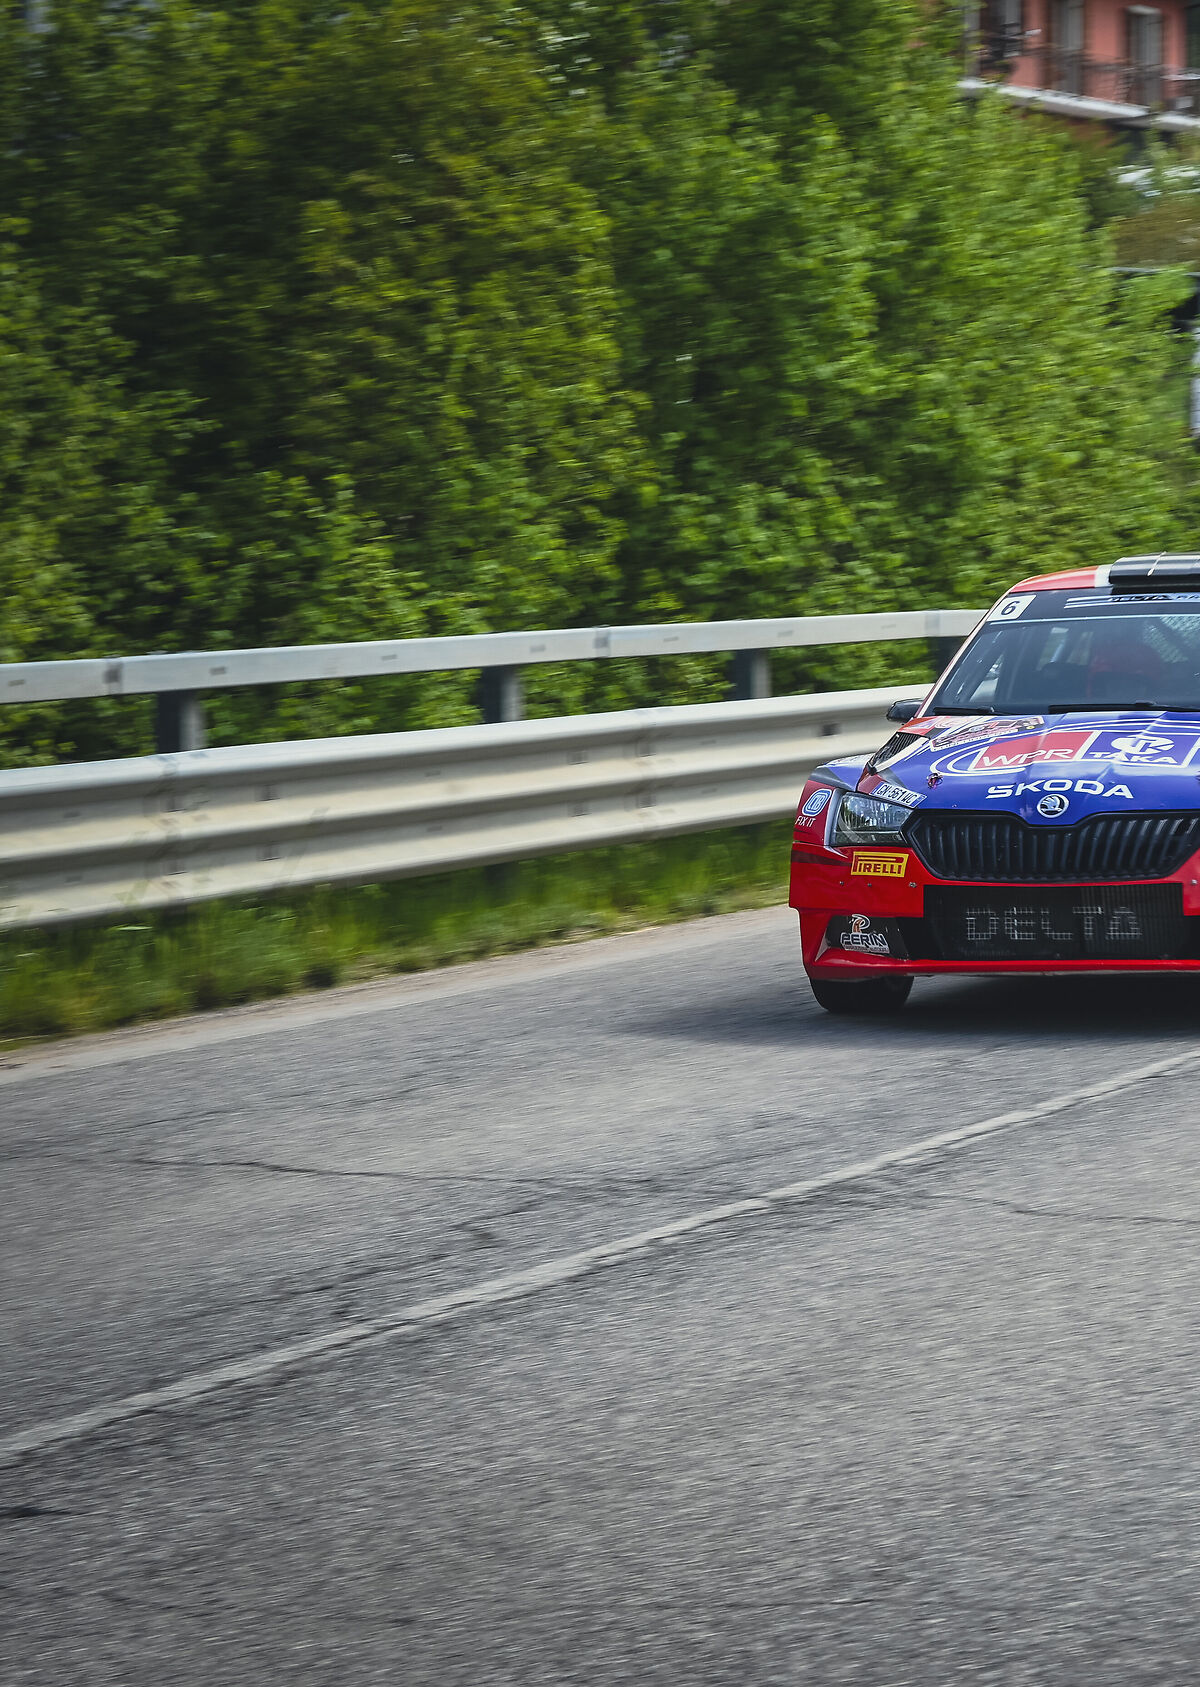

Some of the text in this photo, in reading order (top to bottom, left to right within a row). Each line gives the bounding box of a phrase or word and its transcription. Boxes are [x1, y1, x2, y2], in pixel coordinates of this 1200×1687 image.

[1001, 601, 1020, 615] 6
[982, 748, 1074, 766] WPR
[1089, 751, 1178, 764] TAKA
[986, 779, 1134, 799] SKODA
[853, 855, 904, 874] PIRELLI
[966, 906, 1142, 940] DELTA
[840, 932, 888, 948] PERIN
